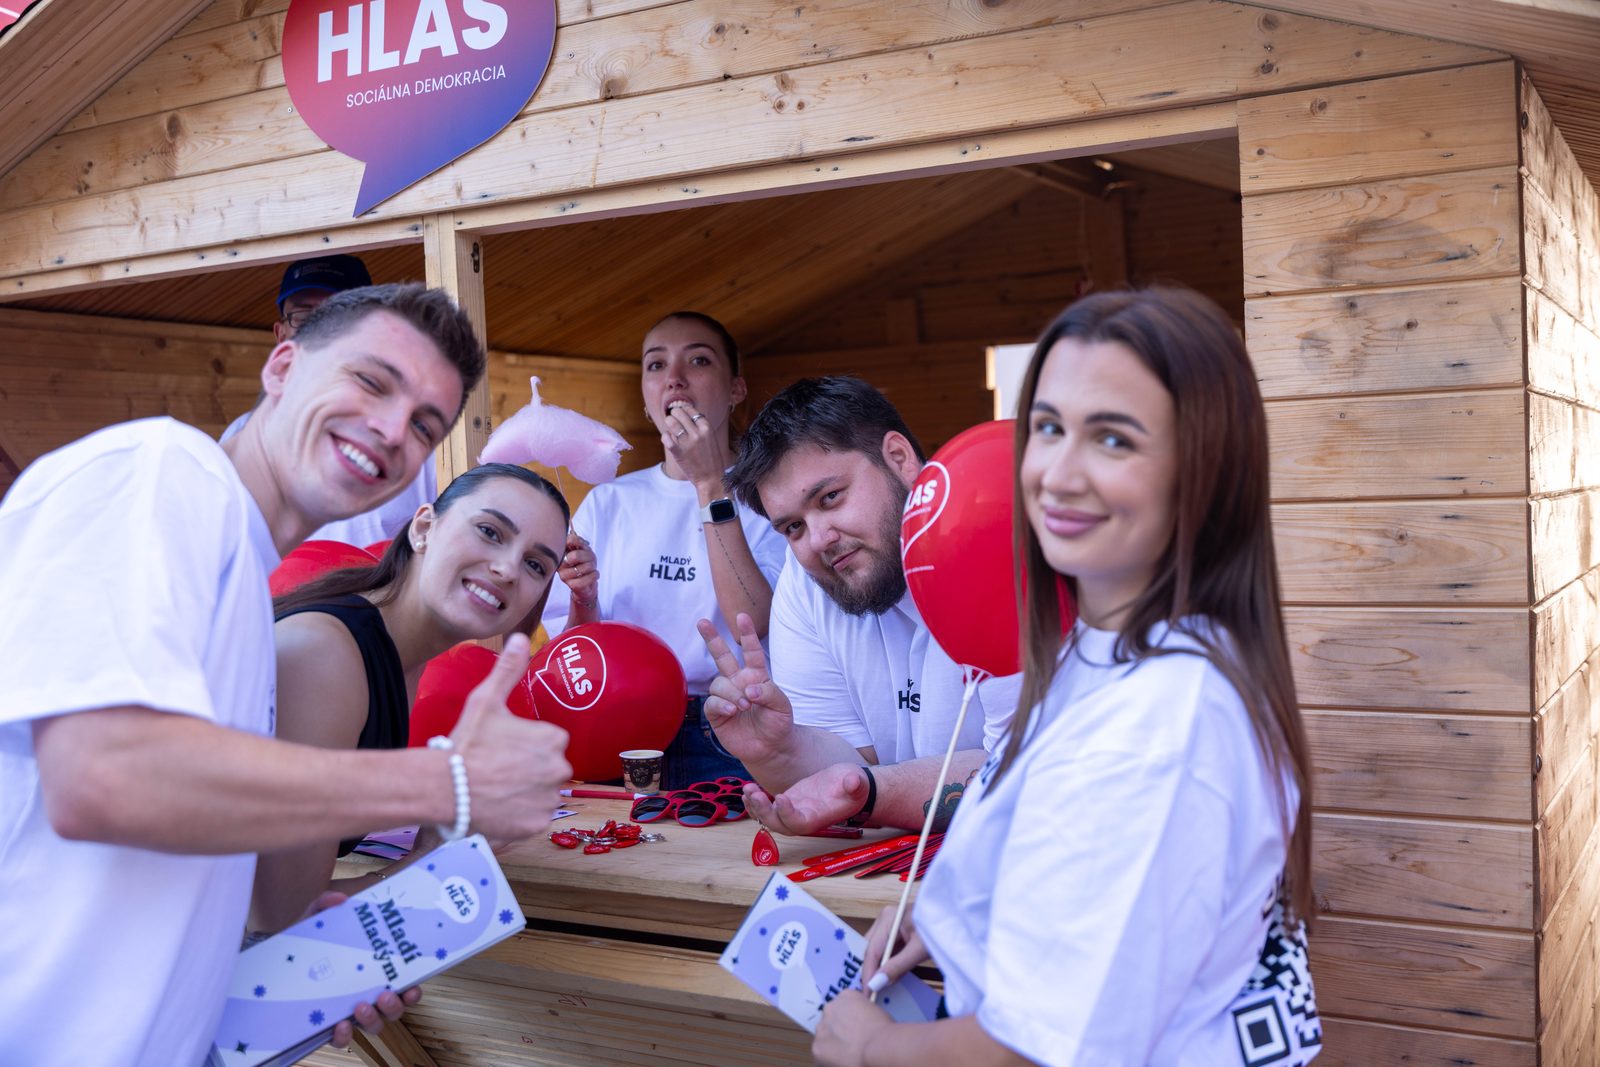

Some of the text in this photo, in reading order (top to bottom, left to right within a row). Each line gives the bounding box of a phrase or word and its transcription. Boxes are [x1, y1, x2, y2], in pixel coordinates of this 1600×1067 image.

[317, 0, 509, 83] HLAS
[346, 65, 506, 108] SOCIÁLNA DEMOKRACIA
[903, 479, 937, 515] LAS
[649, 563, 696, 582] HLAS
[561, 643, 593, 696] HLAS
[445, 883, 471, 917] HLAS
[354, 902, 398, 982] Mladým
[377, 898, 422, 964] Mladí
[778, 929, 802, 965] HLAS
[818, 951, 863, 1011] ladí
